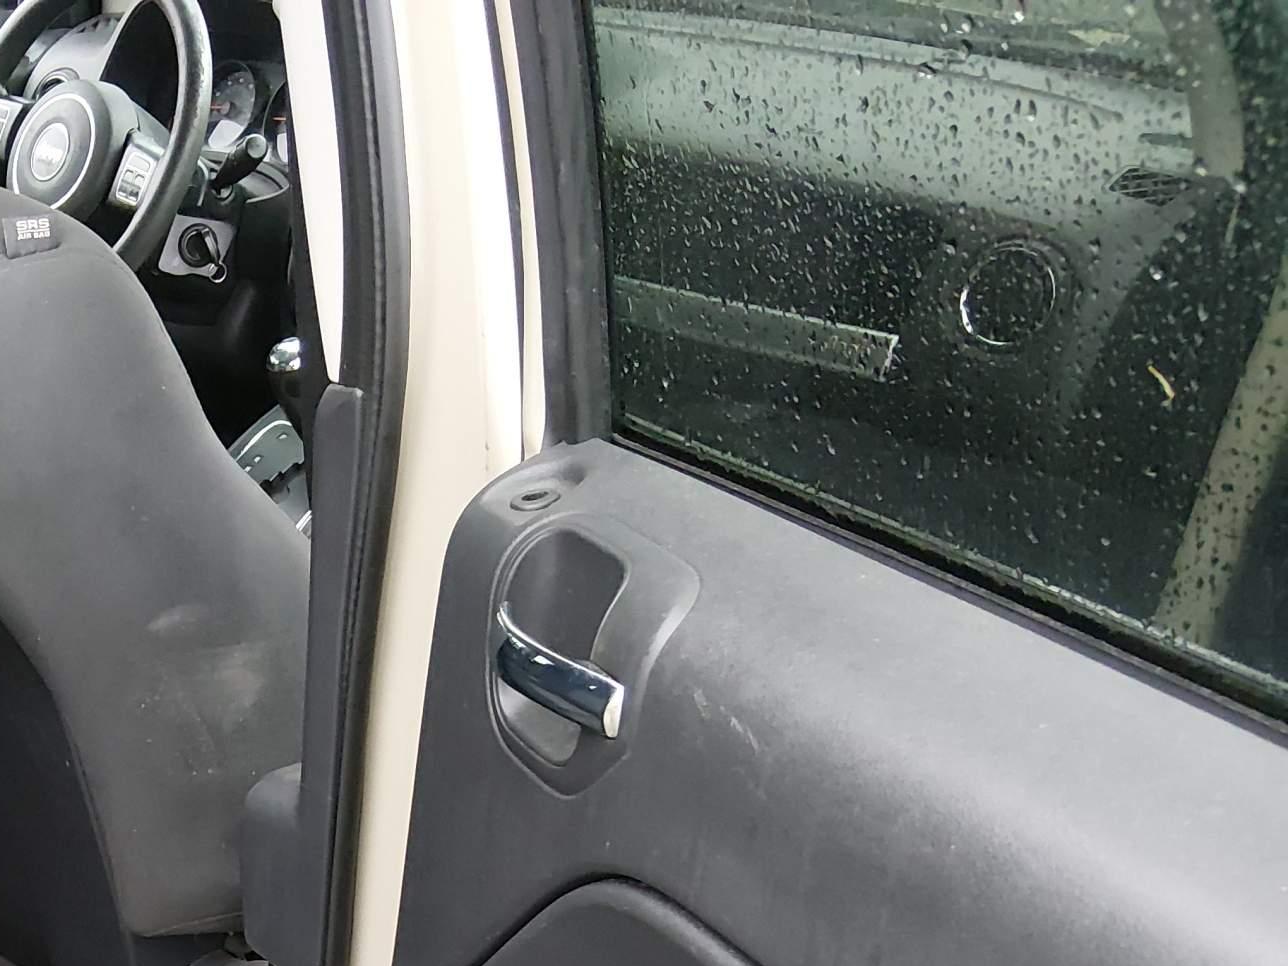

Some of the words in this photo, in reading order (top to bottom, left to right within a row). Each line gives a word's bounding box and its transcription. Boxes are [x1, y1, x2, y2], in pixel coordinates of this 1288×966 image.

[16, 218, 50, 230] SRS
[17, 232, 32, 240] AIR
[33, 231, 50, 239] BAG
